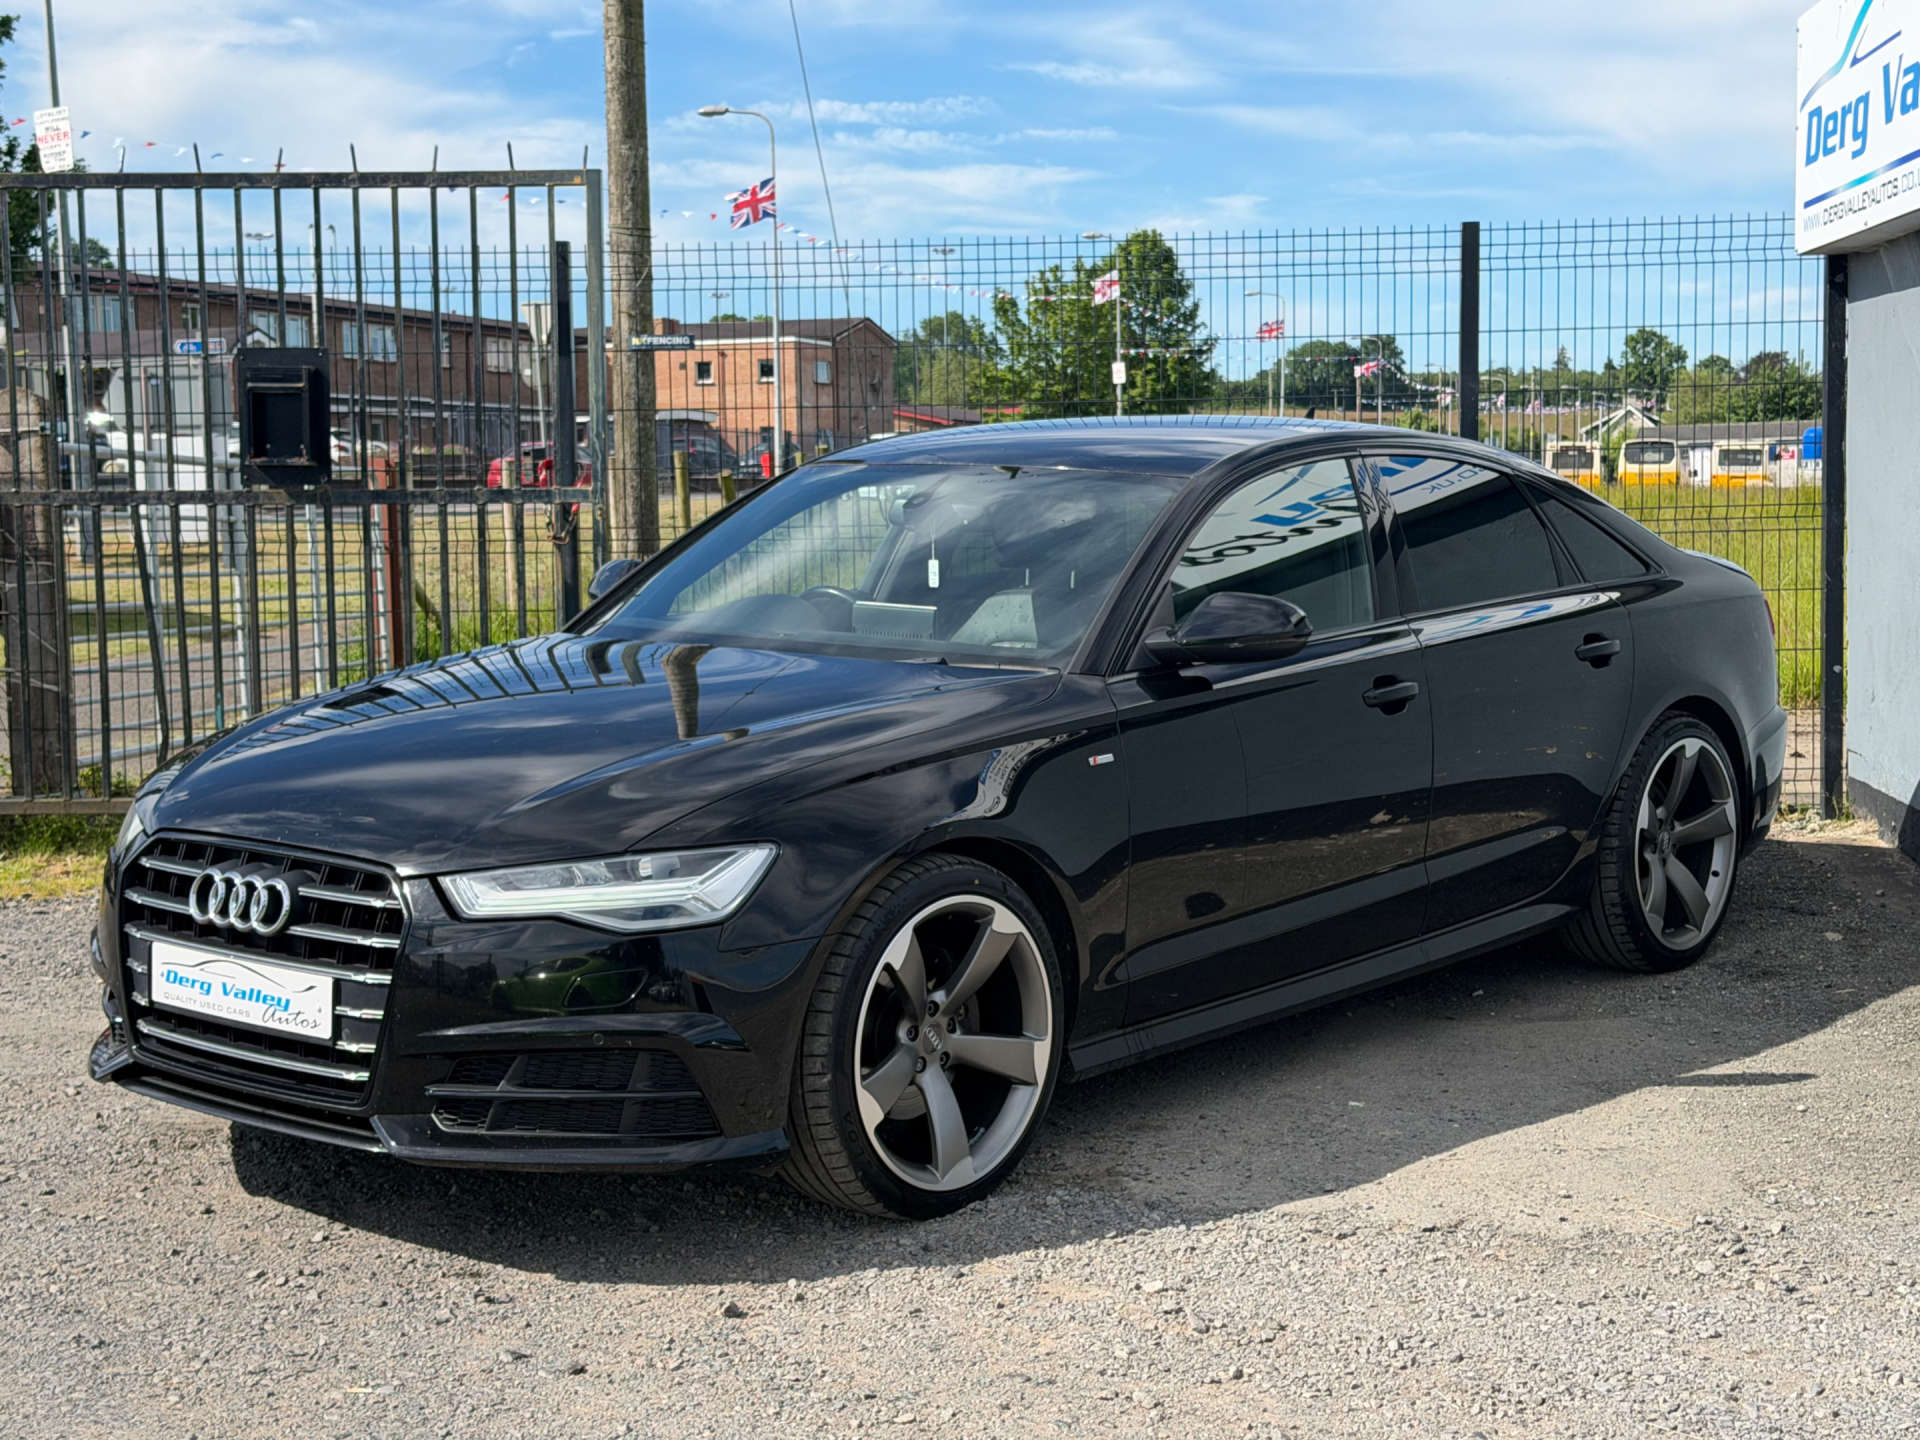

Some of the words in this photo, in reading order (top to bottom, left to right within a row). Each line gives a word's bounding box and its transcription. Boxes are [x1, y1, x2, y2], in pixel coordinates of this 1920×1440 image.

[37, 131, 70, 144] NEVER
[1804, 90, 1870, 168] Derg
[165, 969, 212, 996] Derg
[221, 981, 291, 1012] Valley
[163, 991, 198, 1007] QUALITY
[199, 999, 225, 1013] USED
[226, 1004, 251, 1019] CARS
[262, 1003, 321, 1030] Autos
